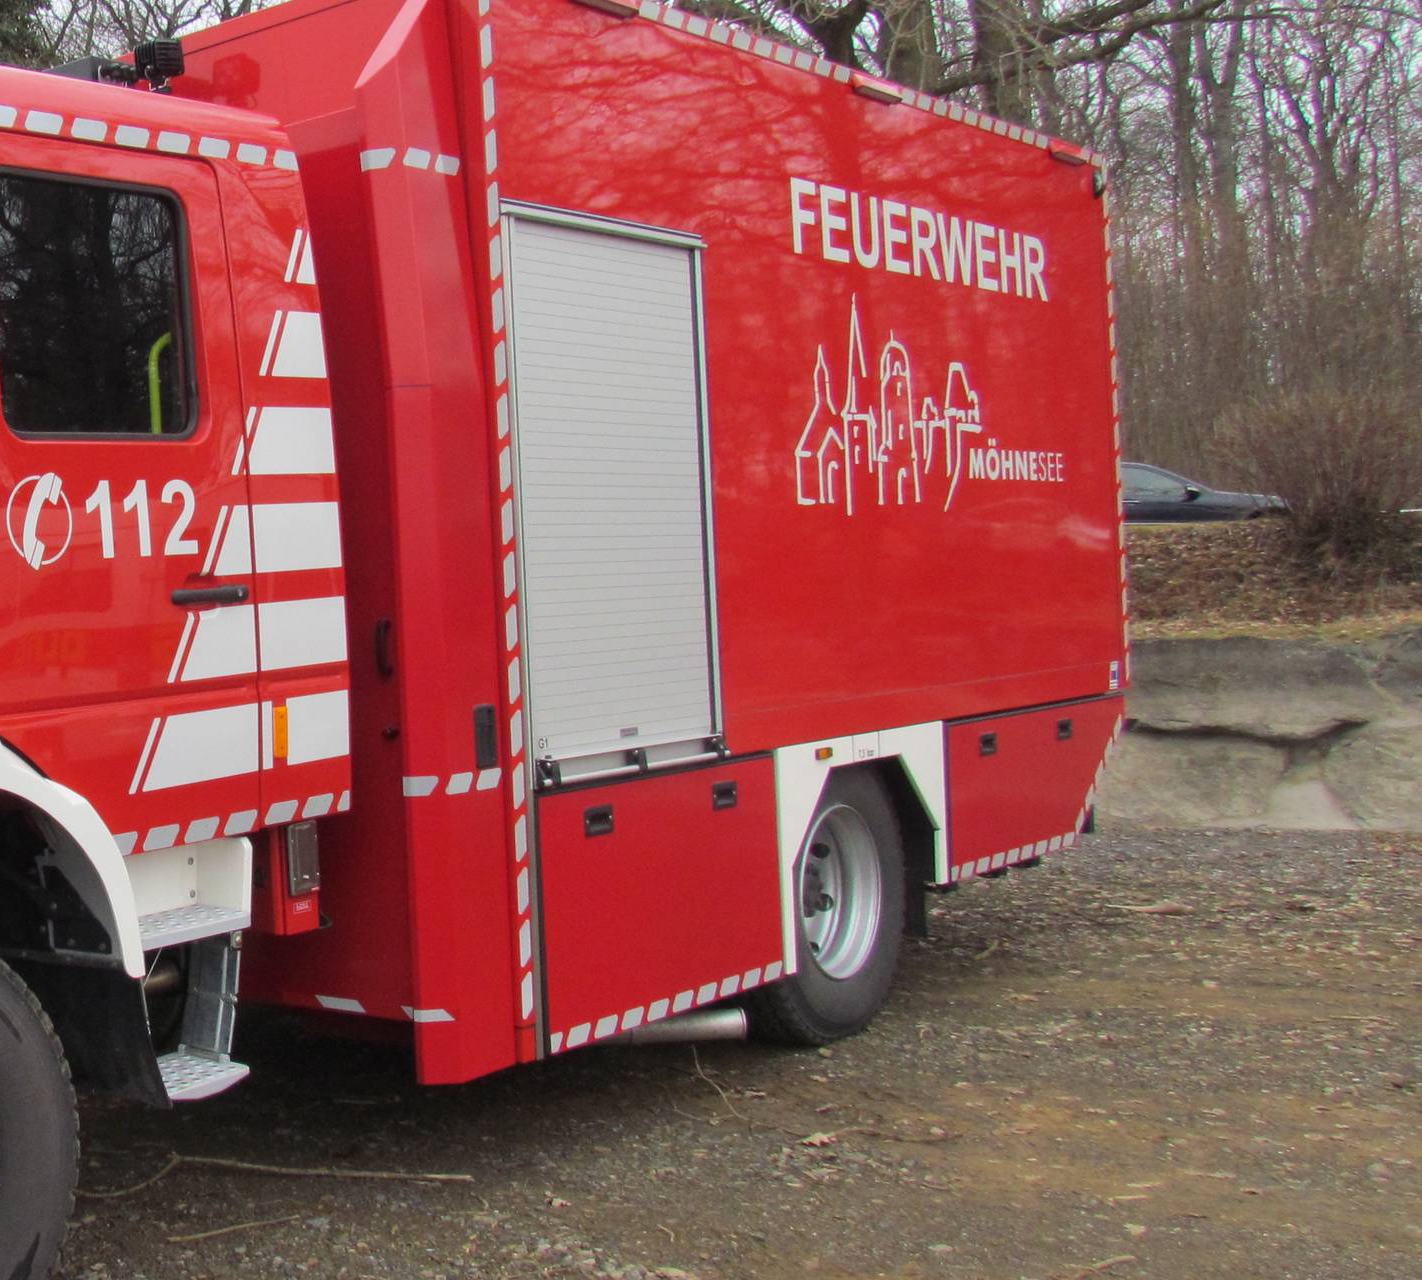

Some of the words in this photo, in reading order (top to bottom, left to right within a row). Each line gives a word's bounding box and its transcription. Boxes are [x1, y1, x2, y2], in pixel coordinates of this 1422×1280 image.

[790, 176, 1049, 303] FEUERWEHR
[968, 437, 1064, 483] MÖHNESEE
[85, 479, 199, 559] 112
[537, 737, 549, 749] G1
